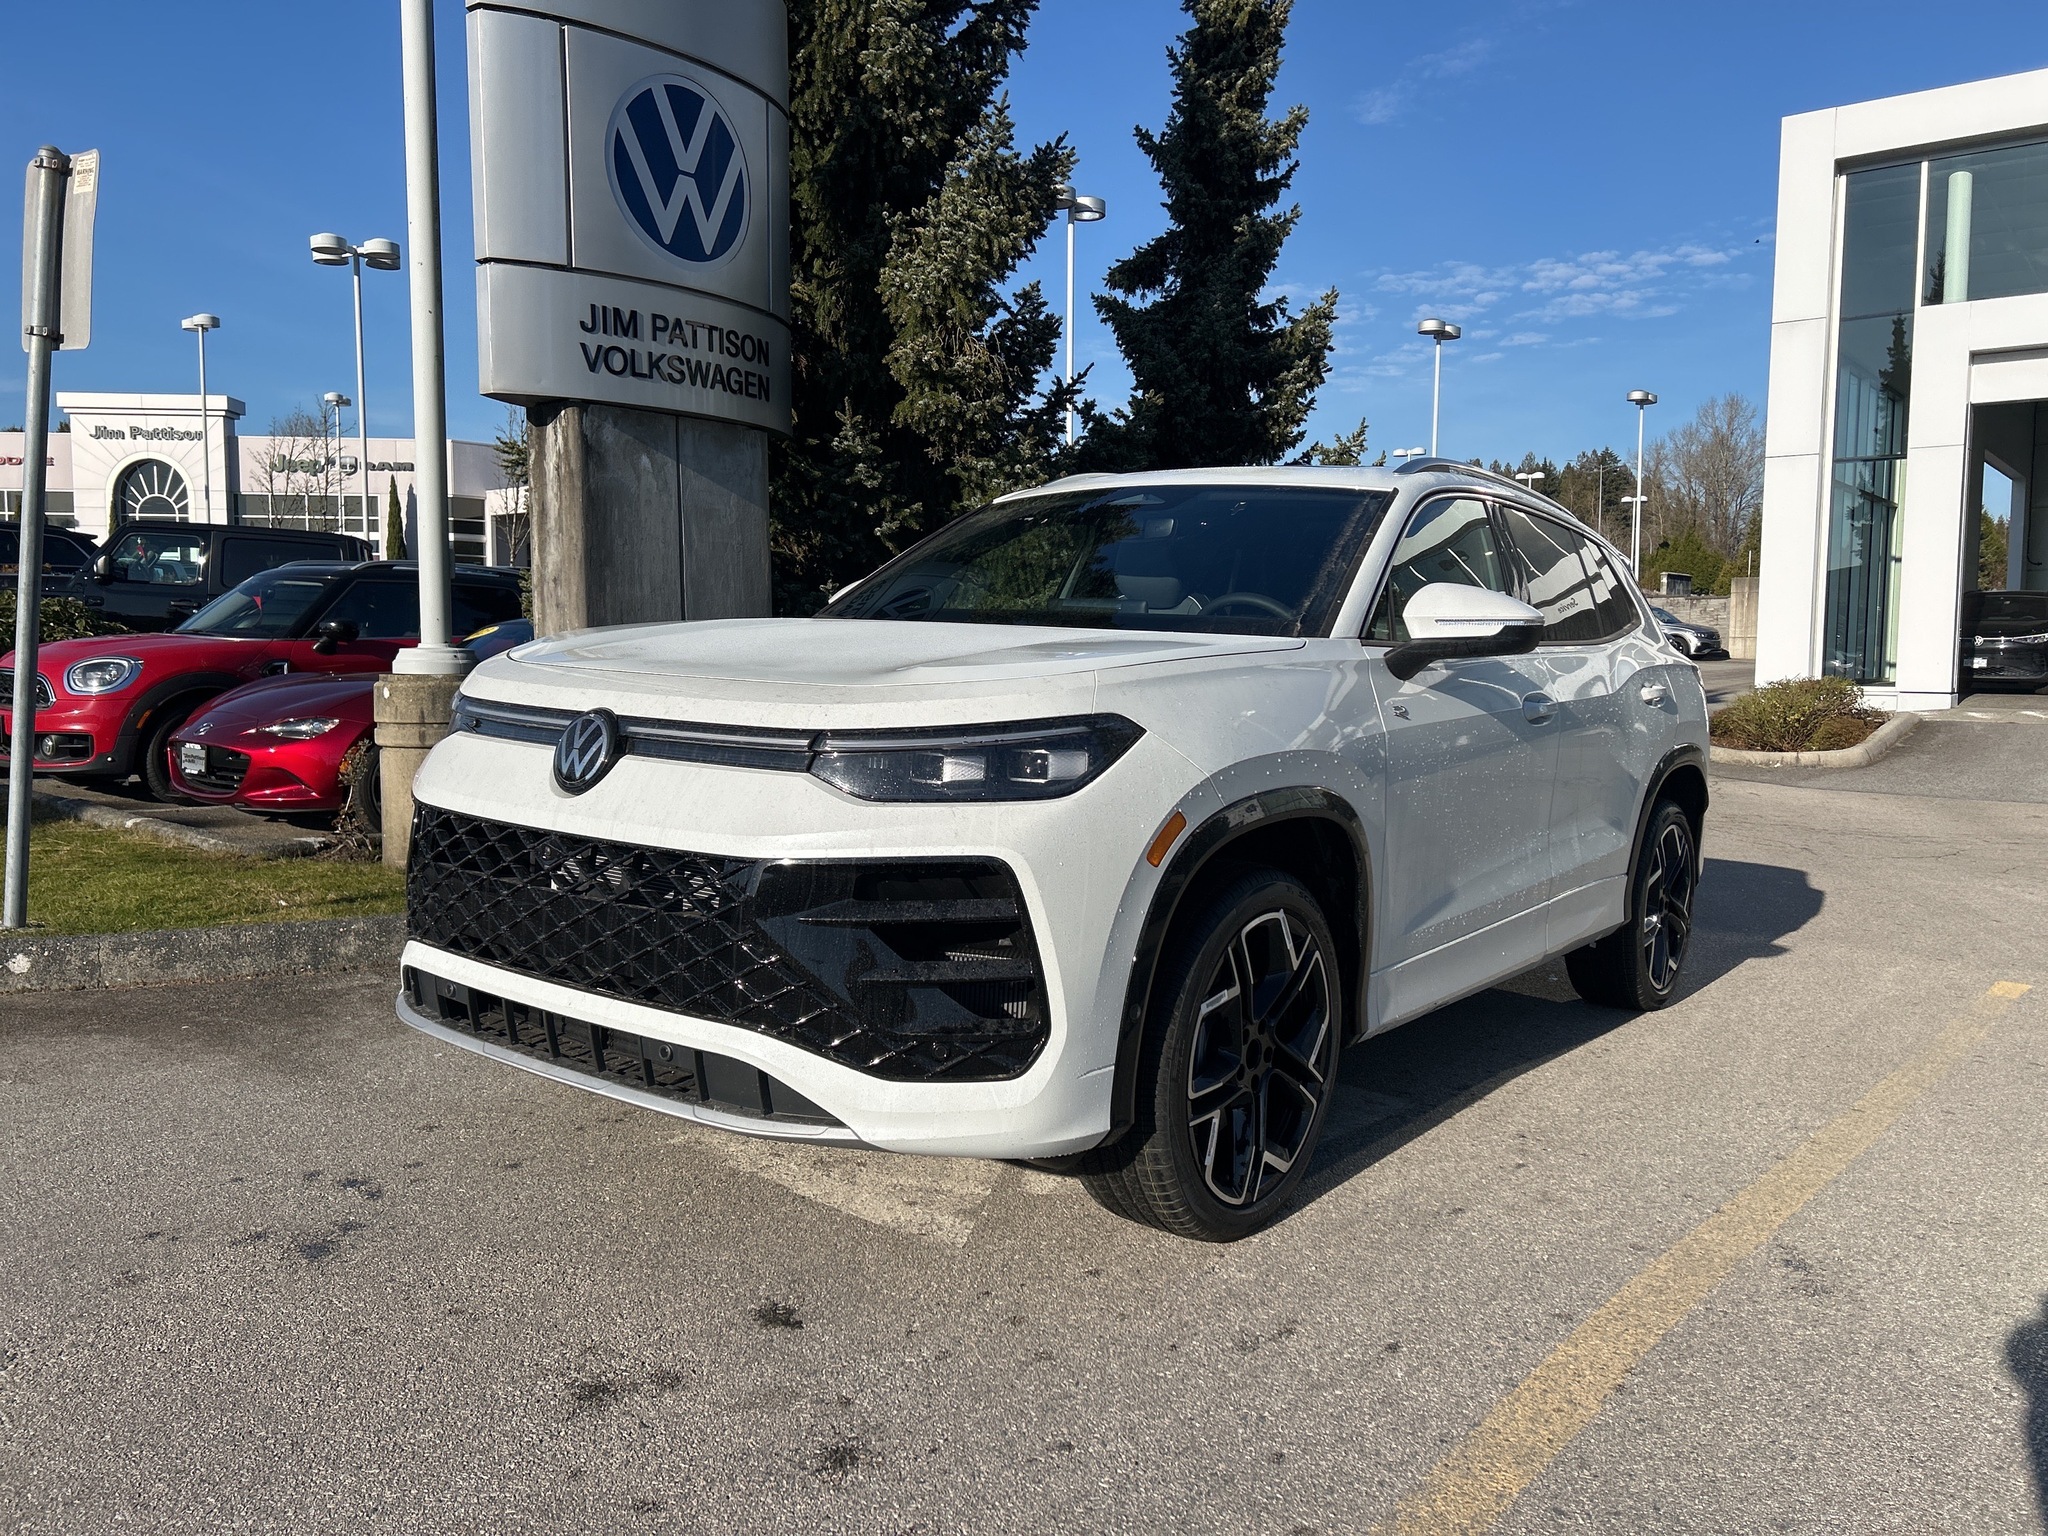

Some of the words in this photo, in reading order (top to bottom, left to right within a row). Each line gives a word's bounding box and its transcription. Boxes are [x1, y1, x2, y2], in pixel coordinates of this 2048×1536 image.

[579, 302, 640, 339] JIM
[651, 311, 770, 368] PATTISON
[579, 341, 770, 402] VOLKSWAGEN
[89, 424, 125, 440] Jim
[129, 425, 204, 442] Pattison
[272, 453, 326, 477] Jeep
[559, 715, 606, 782] VW
